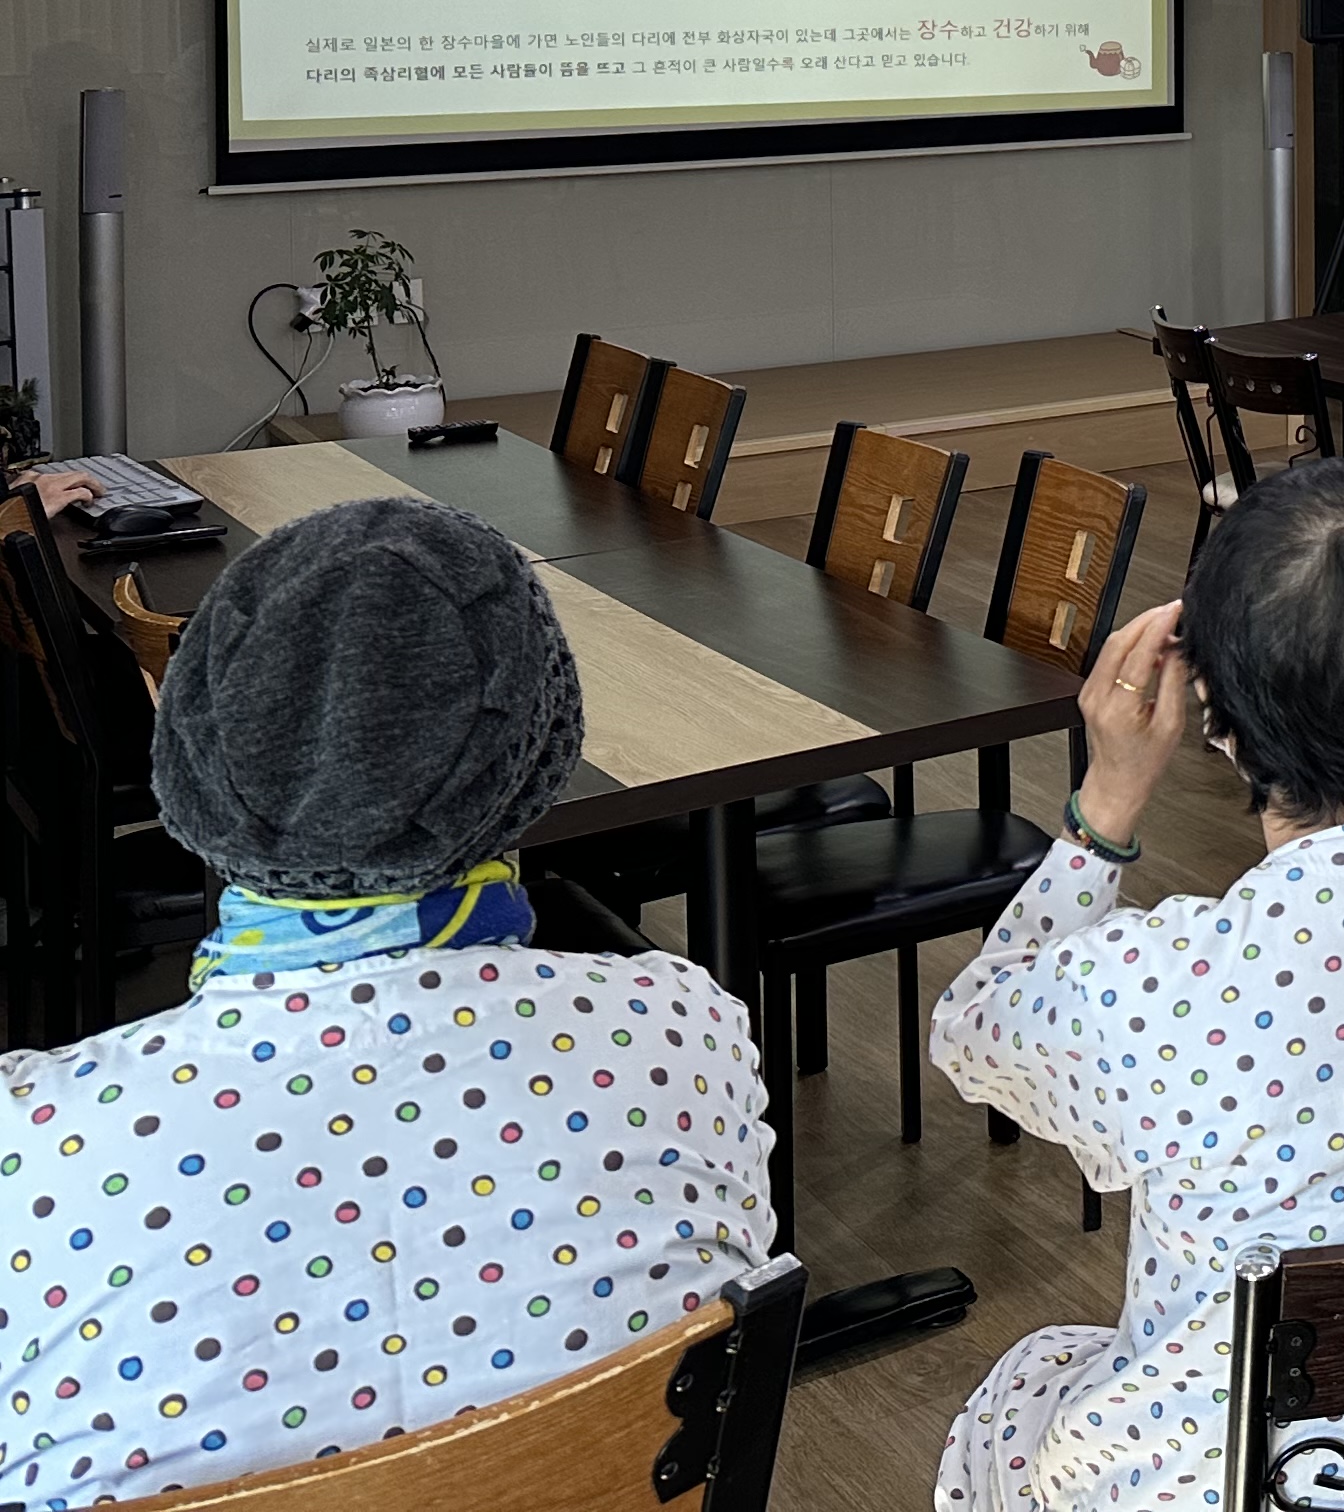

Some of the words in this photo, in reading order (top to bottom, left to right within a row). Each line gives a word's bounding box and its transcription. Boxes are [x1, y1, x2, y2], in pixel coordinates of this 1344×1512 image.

[304, 36, 357, 54] 실제로
[363, 35, 412, 53] 일본의
[418, 35, 435, 52] 한
[440, 33, 521, 51] 장수마을에
[527, 33, 558, 50] 가면
[563, 31, 625, 48] 노인들의
[631, 30, 676, 47] 다리에
[681, 30, 712, 46] 전부
[716, 28, 789, 45] 화상자국이
[795, 27, 837, 44] 있는데
[841, 26, 912, 43] 그곳에서는
[917, 18, 987, 41] 장수하고
[992, 17, 1059, 39] 건강하기
[1064, 22, 1090, 37] 위해
[306, 66, 356, 85] 다리의
[451, 63, 485, 80] 모든
[489, 62, 553, 80] 사람들이
[559, 61, 591, 78] 뜸을
[595, 61, 627, 75] 뜨고
[631, 61, 648, 74] 그
[652, 58, 697, 75] 흔적이
[702, 58, 717, 74] 큰
[799, 55, 828, 71] 오래
[833, 54, 877, 70] 산다고
[881, 53, 908, 69] 믿고
